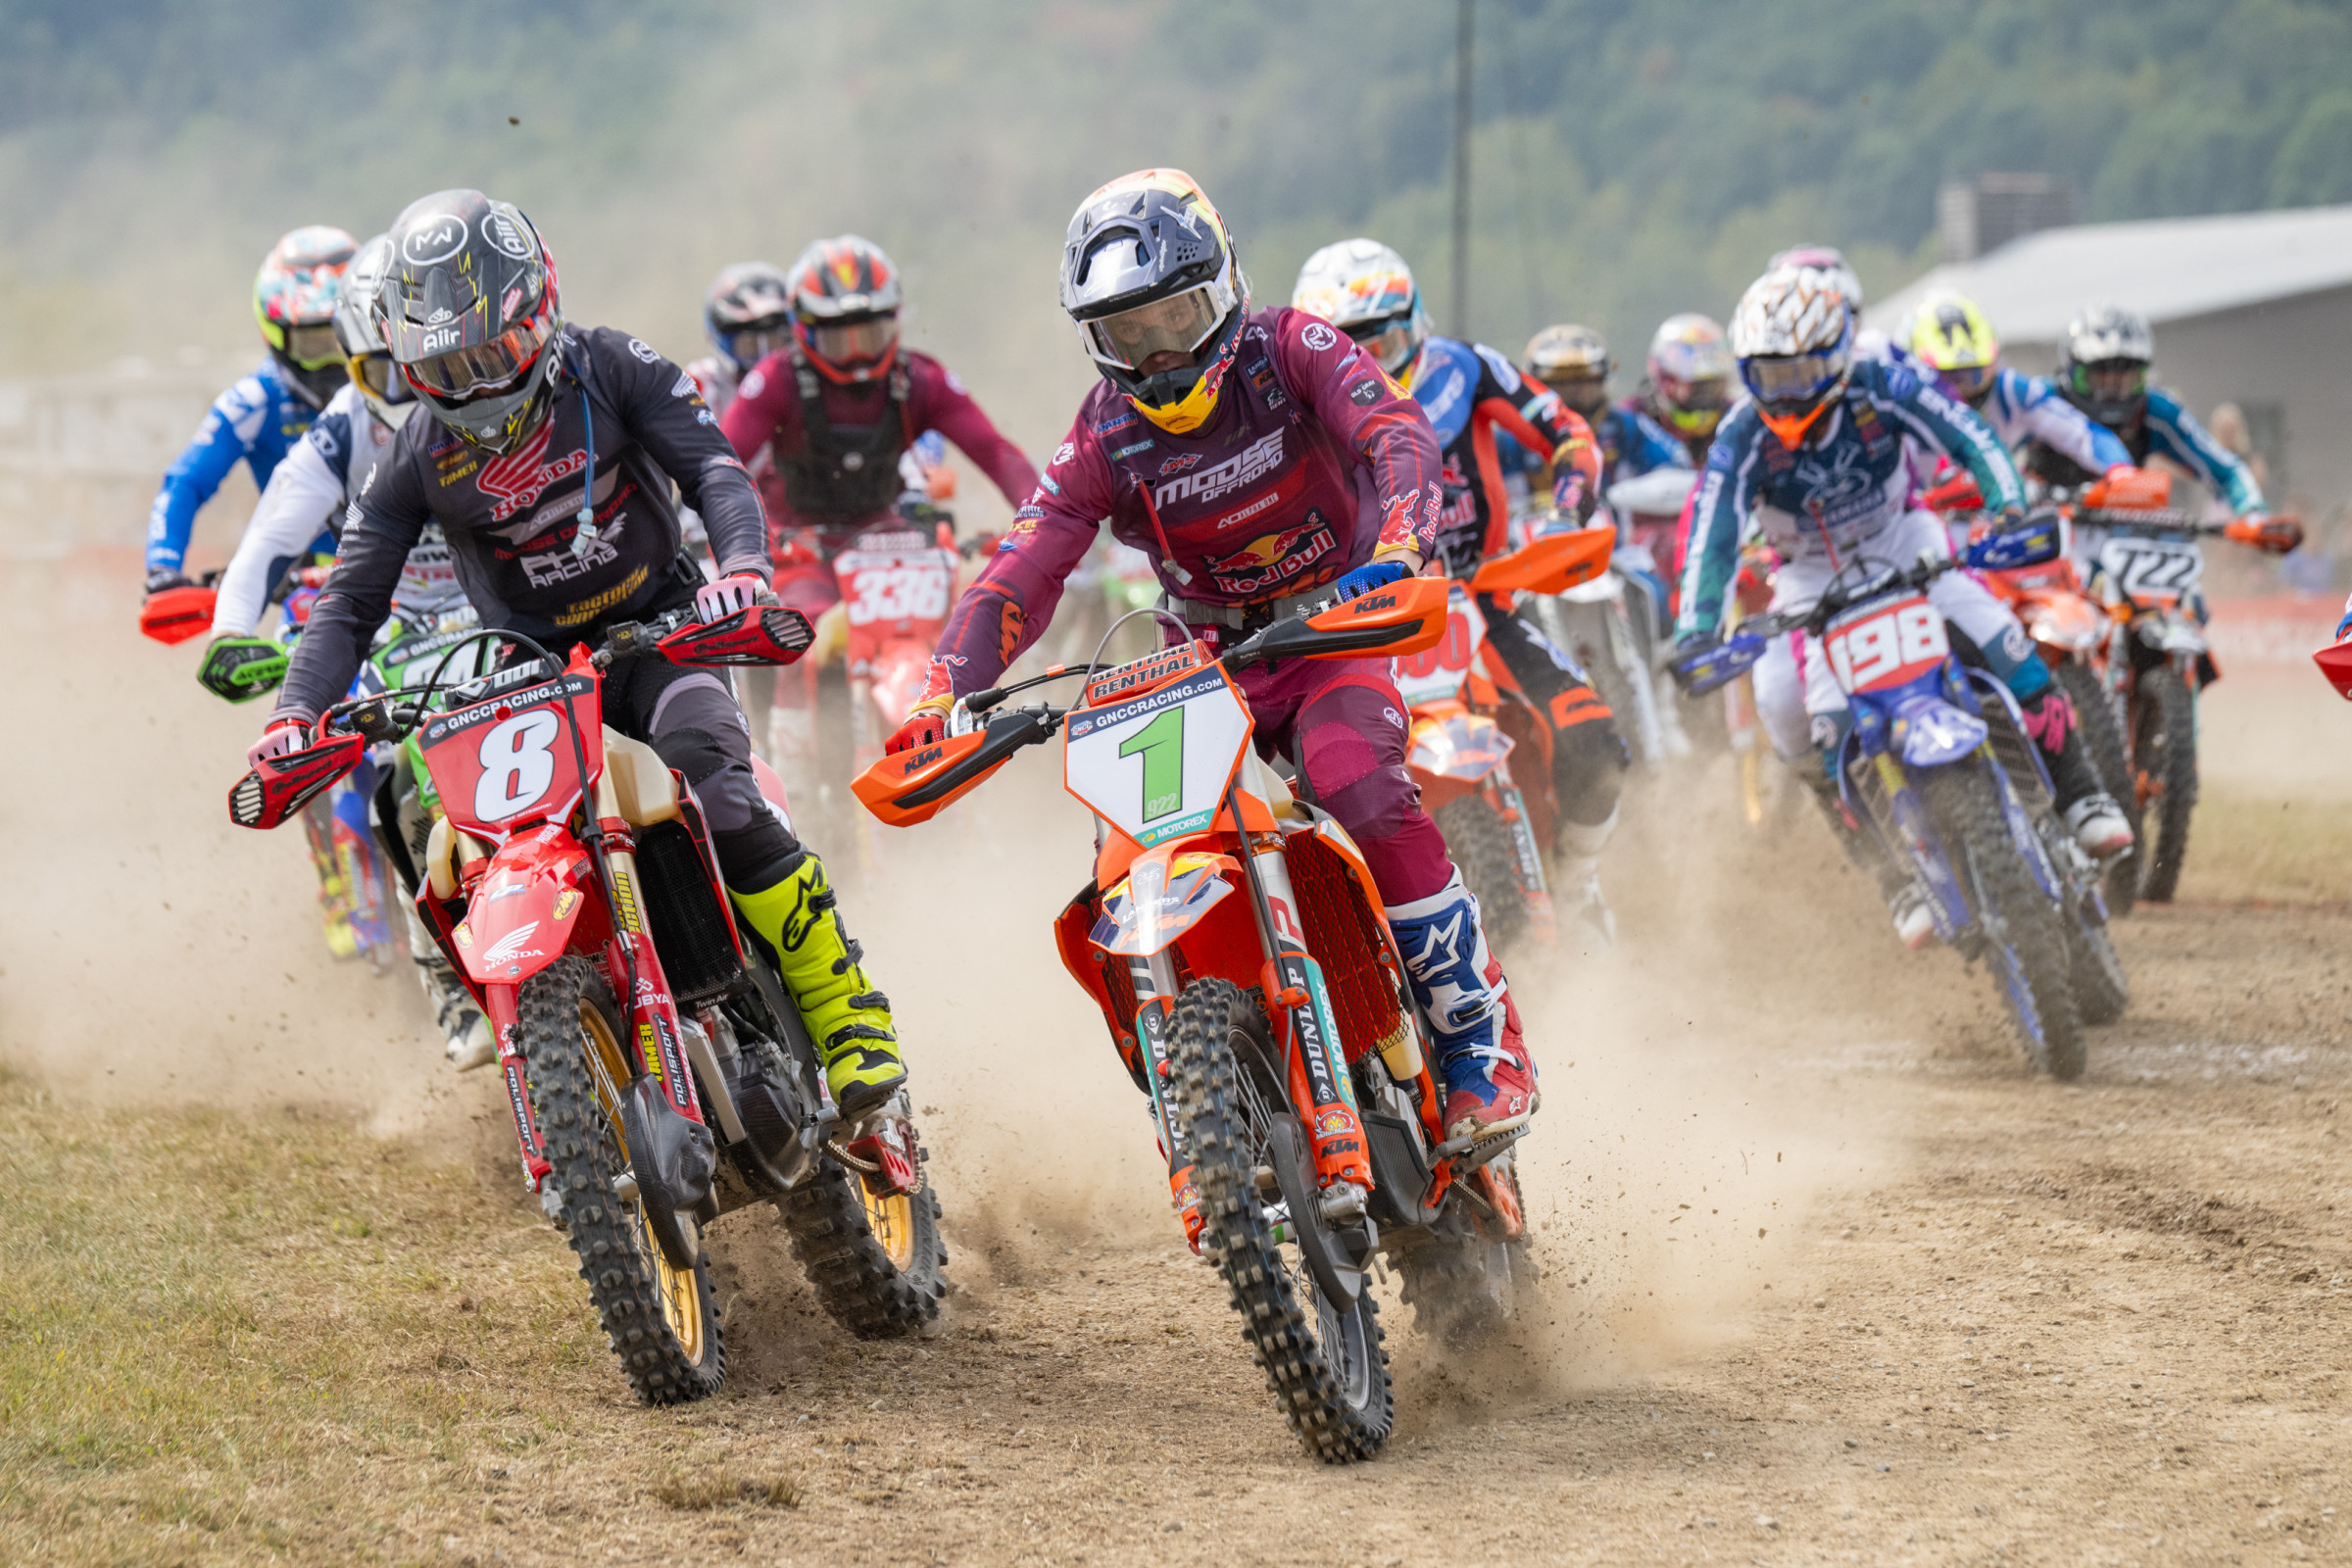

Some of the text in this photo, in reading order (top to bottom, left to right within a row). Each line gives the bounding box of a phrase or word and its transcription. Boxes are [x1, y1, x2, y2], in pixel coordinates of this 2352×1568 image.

[489, 448, 594, 522] HONDA
[1154, 425, 1286, 512] MOOSE
[1160, 454, 1199, 474] IMS
[1201, 450, 1284, 504] OFFROAD
[1418, 480, 1443, 544] Red Bull
[528, 543, 619, 589] RACING
[1213, 529, 1337, 594] Red Bull
[2114, 549, 2195, 588] 722
[1353, 594, 1396, 614] KTM
[1828, 603, 1950, 695] 198
[1093, 654, 1197, 700] RENTHAL
[1096, 677, 1223, 728] GNCCRACING.COM
[474, 709, 560, 823] 8
[904, 746, 943, 775] KTM
[1118, 704, 1186, 824] 1
[1147, 792, 1177, 817] 922
[1157, 813, 1207, 839] MOTOREX
[484, 948, 546, 973] HONDA
[695, 992, 729, 1009] Twin Air
[1286, 966, 1330, 1081] DUNLP
[1317, 984, 1348, 1076] MOTOREX
[659, 1017, 688, 1106] POLISPORT
[507, 1065, 536, 1154] POLISPORT
[1320, 1138, 1360, 1159] KTM
